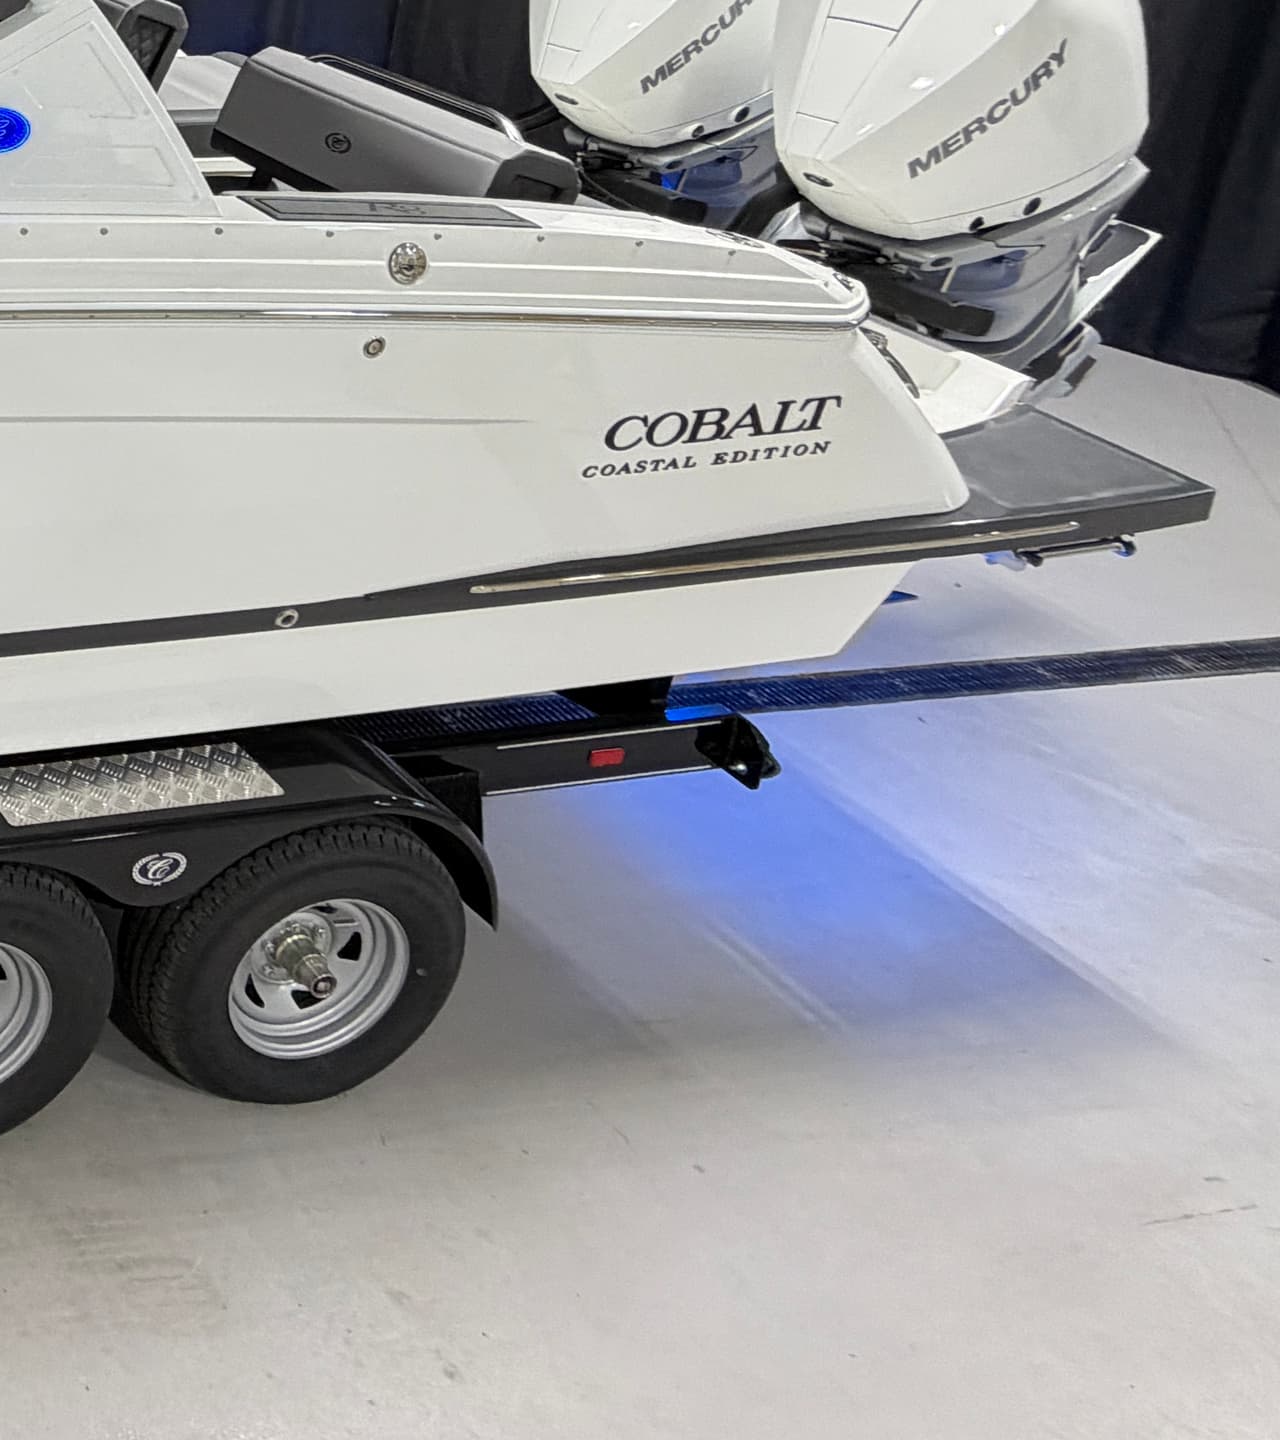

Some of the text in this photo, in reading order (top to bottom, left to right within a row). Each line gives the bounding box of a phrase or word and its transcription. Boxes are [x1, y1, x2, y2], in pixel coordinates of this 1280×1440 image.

[907, 37, 1068, 180] MERCURY
[604, 395, 842, 452] COBALT
[581, 440, 832, 479] COASTAL EDITION
